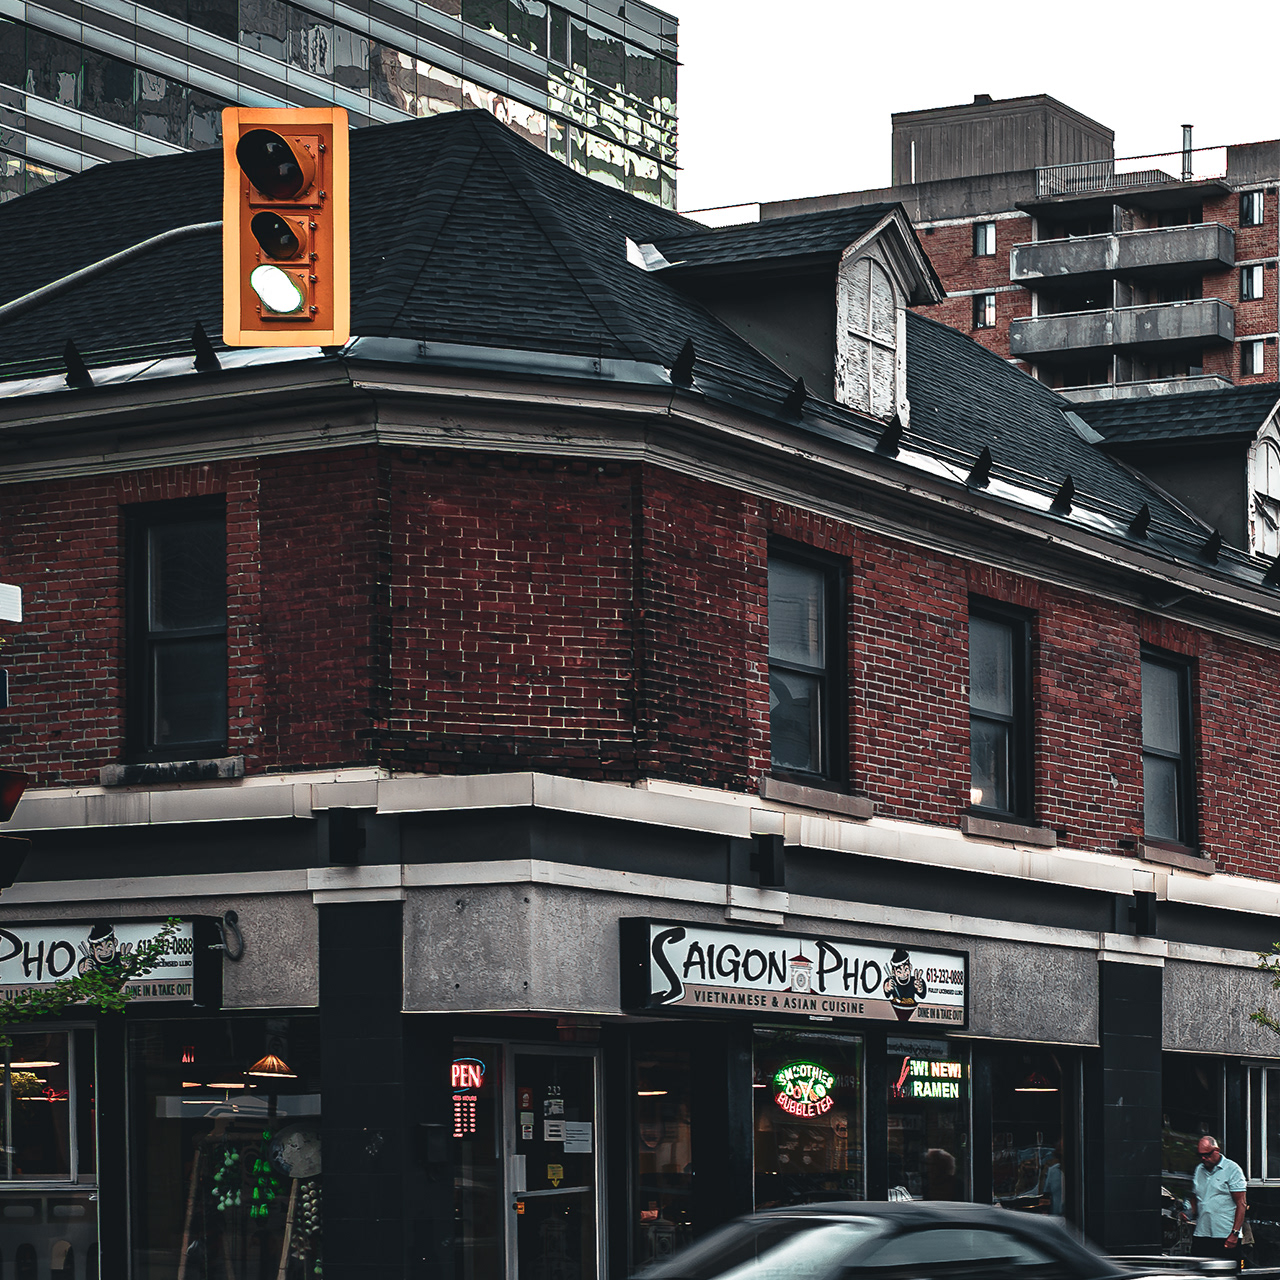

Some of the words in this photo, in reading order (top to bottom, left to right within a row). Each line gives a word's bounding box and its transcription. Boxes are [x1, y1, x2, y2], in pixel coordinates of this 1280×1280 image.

[650, 926, 787, 1002] SAIGON
[815, 939, 882, 995] PHO
[143, 985, 150, 996] IN
[158, 984, 175, 996] TAKE
[177, 984, 191, 996] OUT
[694, 990, 767, 1008] VIETNAMESE
[772, 998, 779, 1008] &
[783, 997, 817, 1010] ASIAN
[822, 1000, 865, 1014] CUISINE
[451, 1064, 481, 1088] PEN
[777, 1065, 834, 1089] SMOOTHIES
[547, 1085, 561, 1095] 232
[913, 1081, 960, 1098] RAMEN
[776, 1092, 816, 1117] BUBBLE
[816, 1096, 834, 1114] TEA
